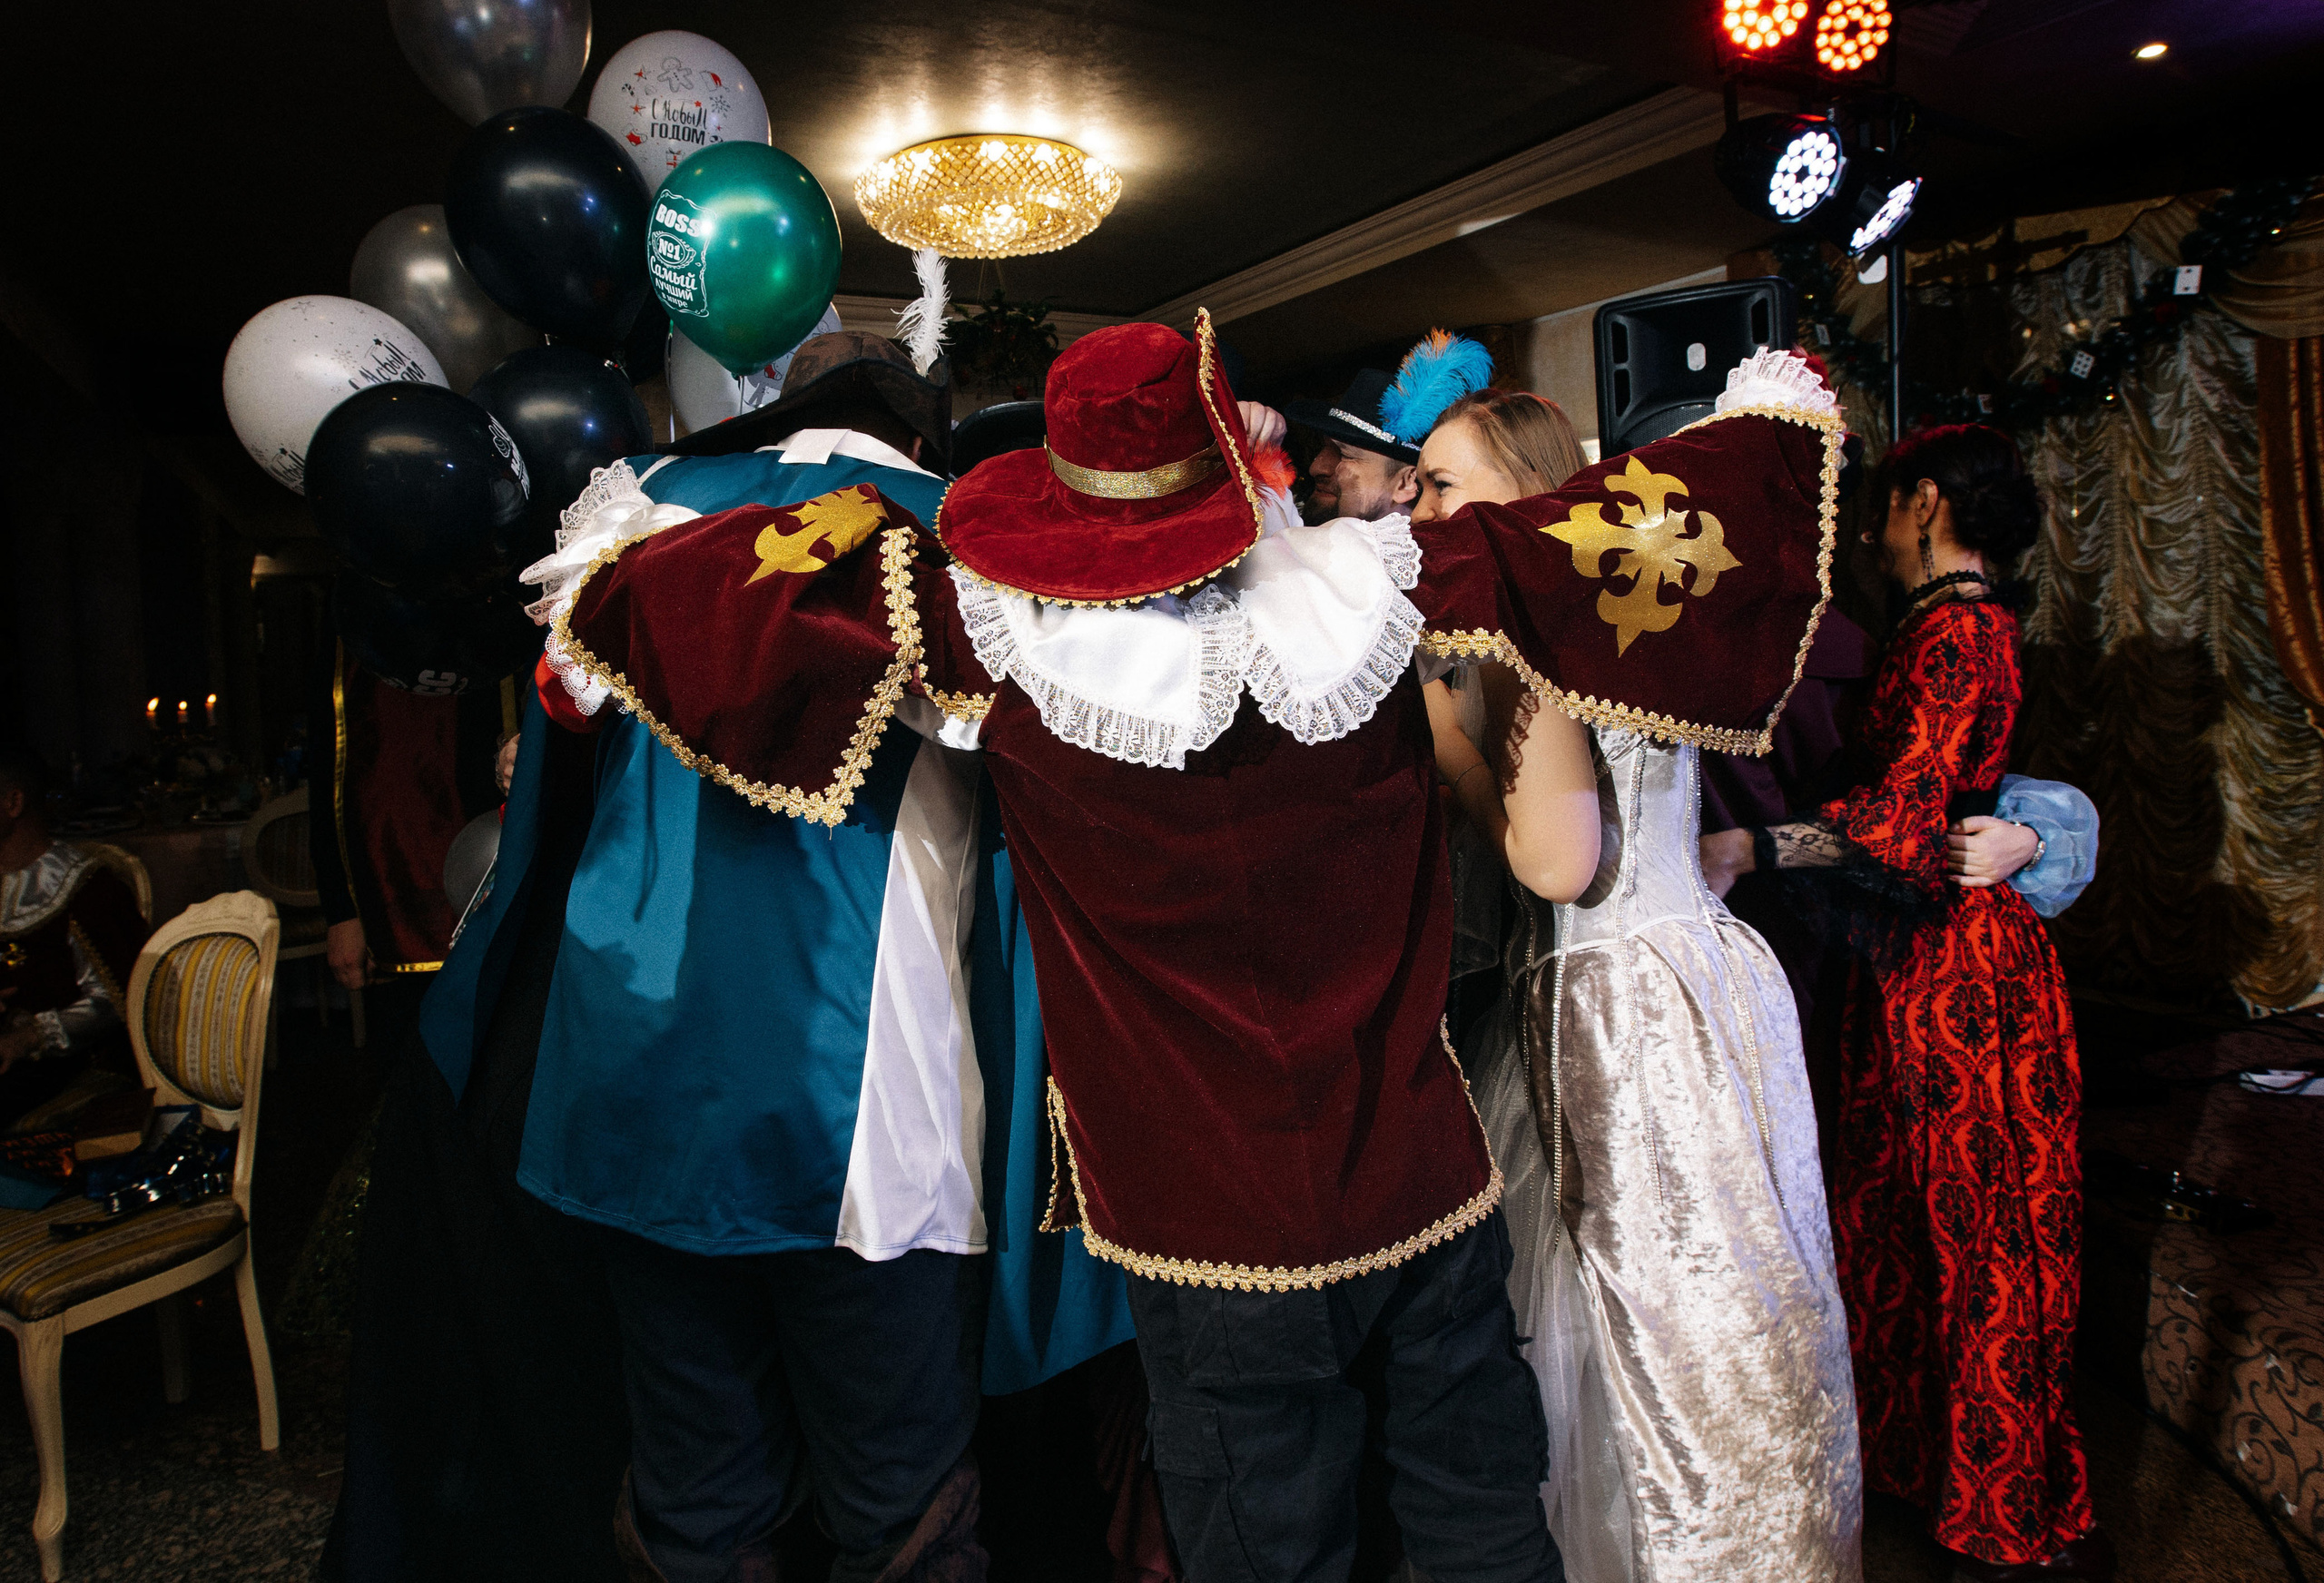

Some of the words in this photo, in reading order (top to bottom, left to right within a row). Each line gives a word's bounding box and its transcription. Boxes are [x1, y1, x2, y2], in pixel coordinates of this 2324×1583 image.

[650, 122, 706, 146] ГОДОМ
[655, 203, 704, 238] BOSS
[650, 255, 698, 290] Самый
